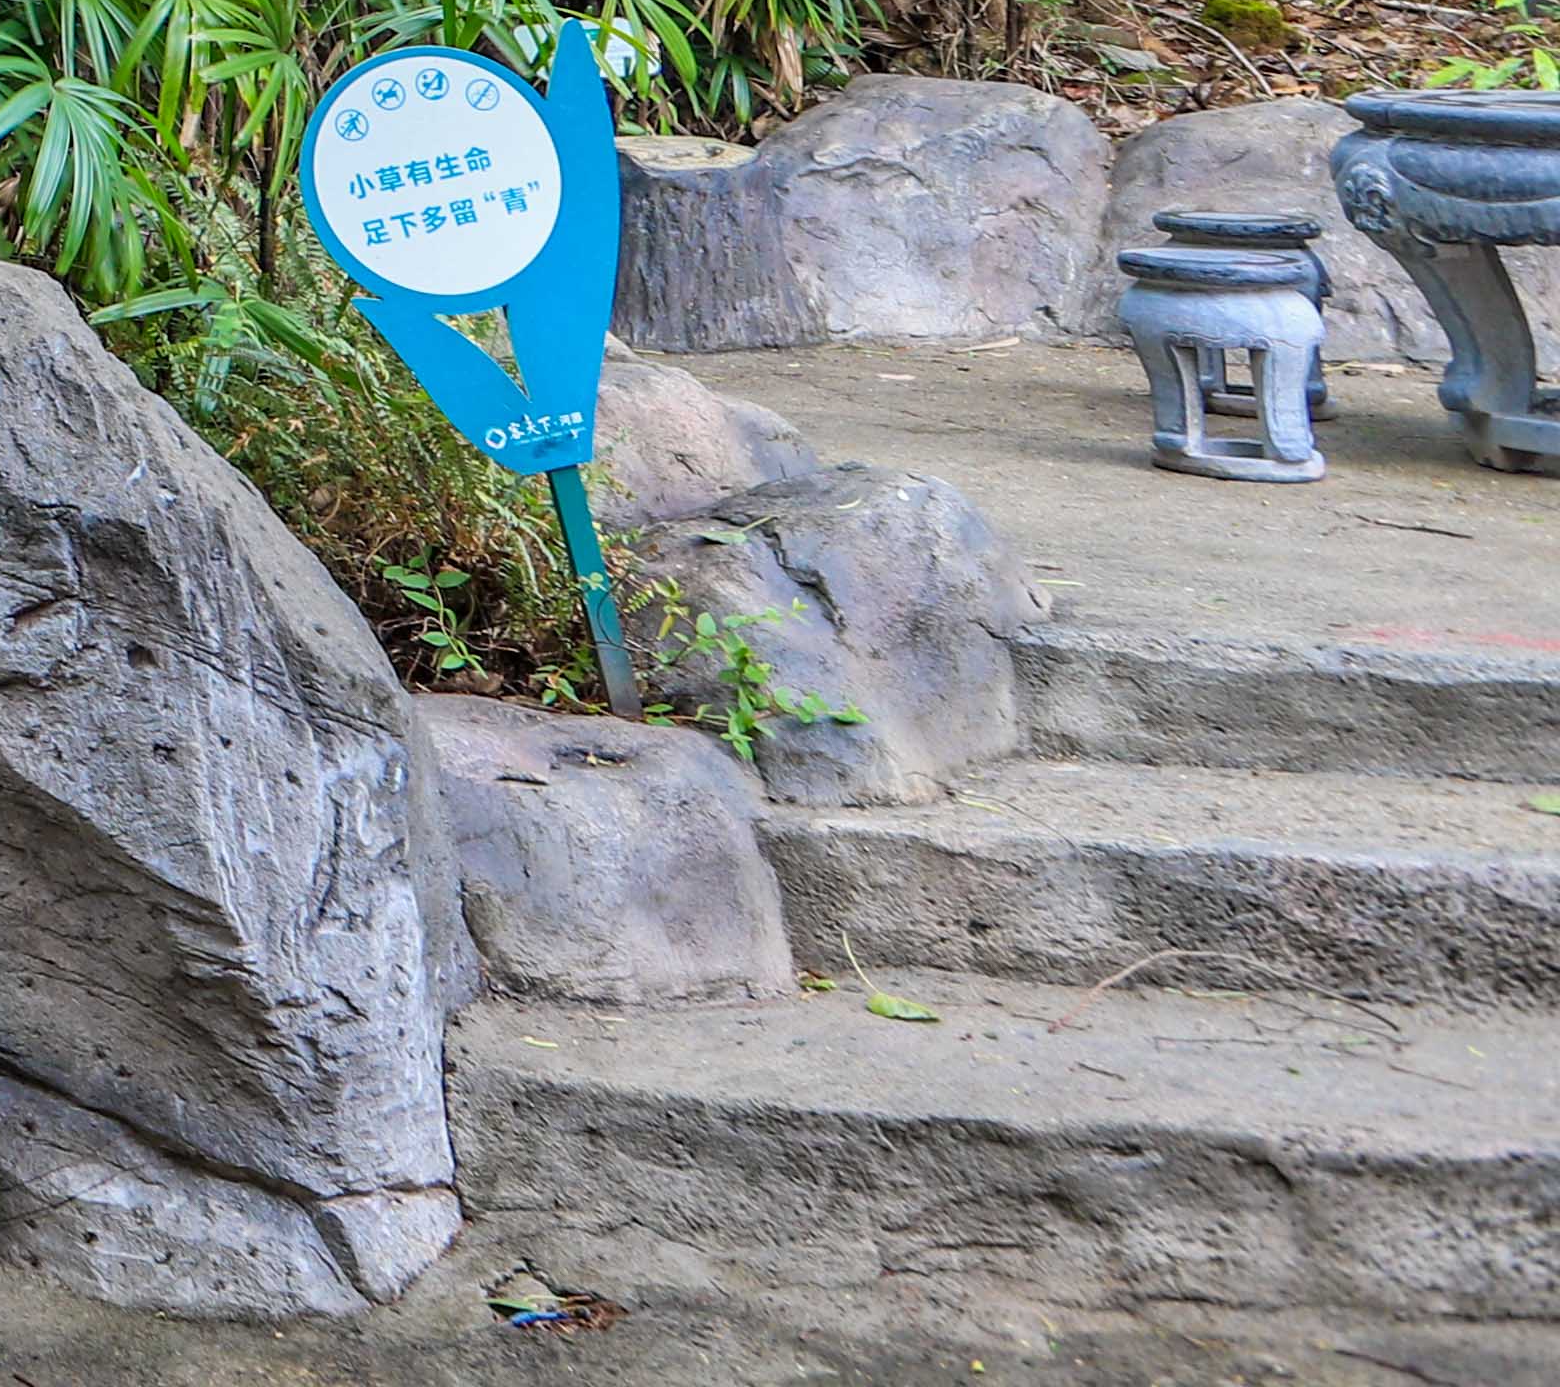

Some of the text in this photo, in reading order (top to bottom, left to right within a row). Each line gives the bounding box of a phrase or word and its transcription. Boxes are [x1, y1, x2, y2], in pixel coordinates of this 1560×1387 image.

[349, 146, 492, 200] 小草有生命
